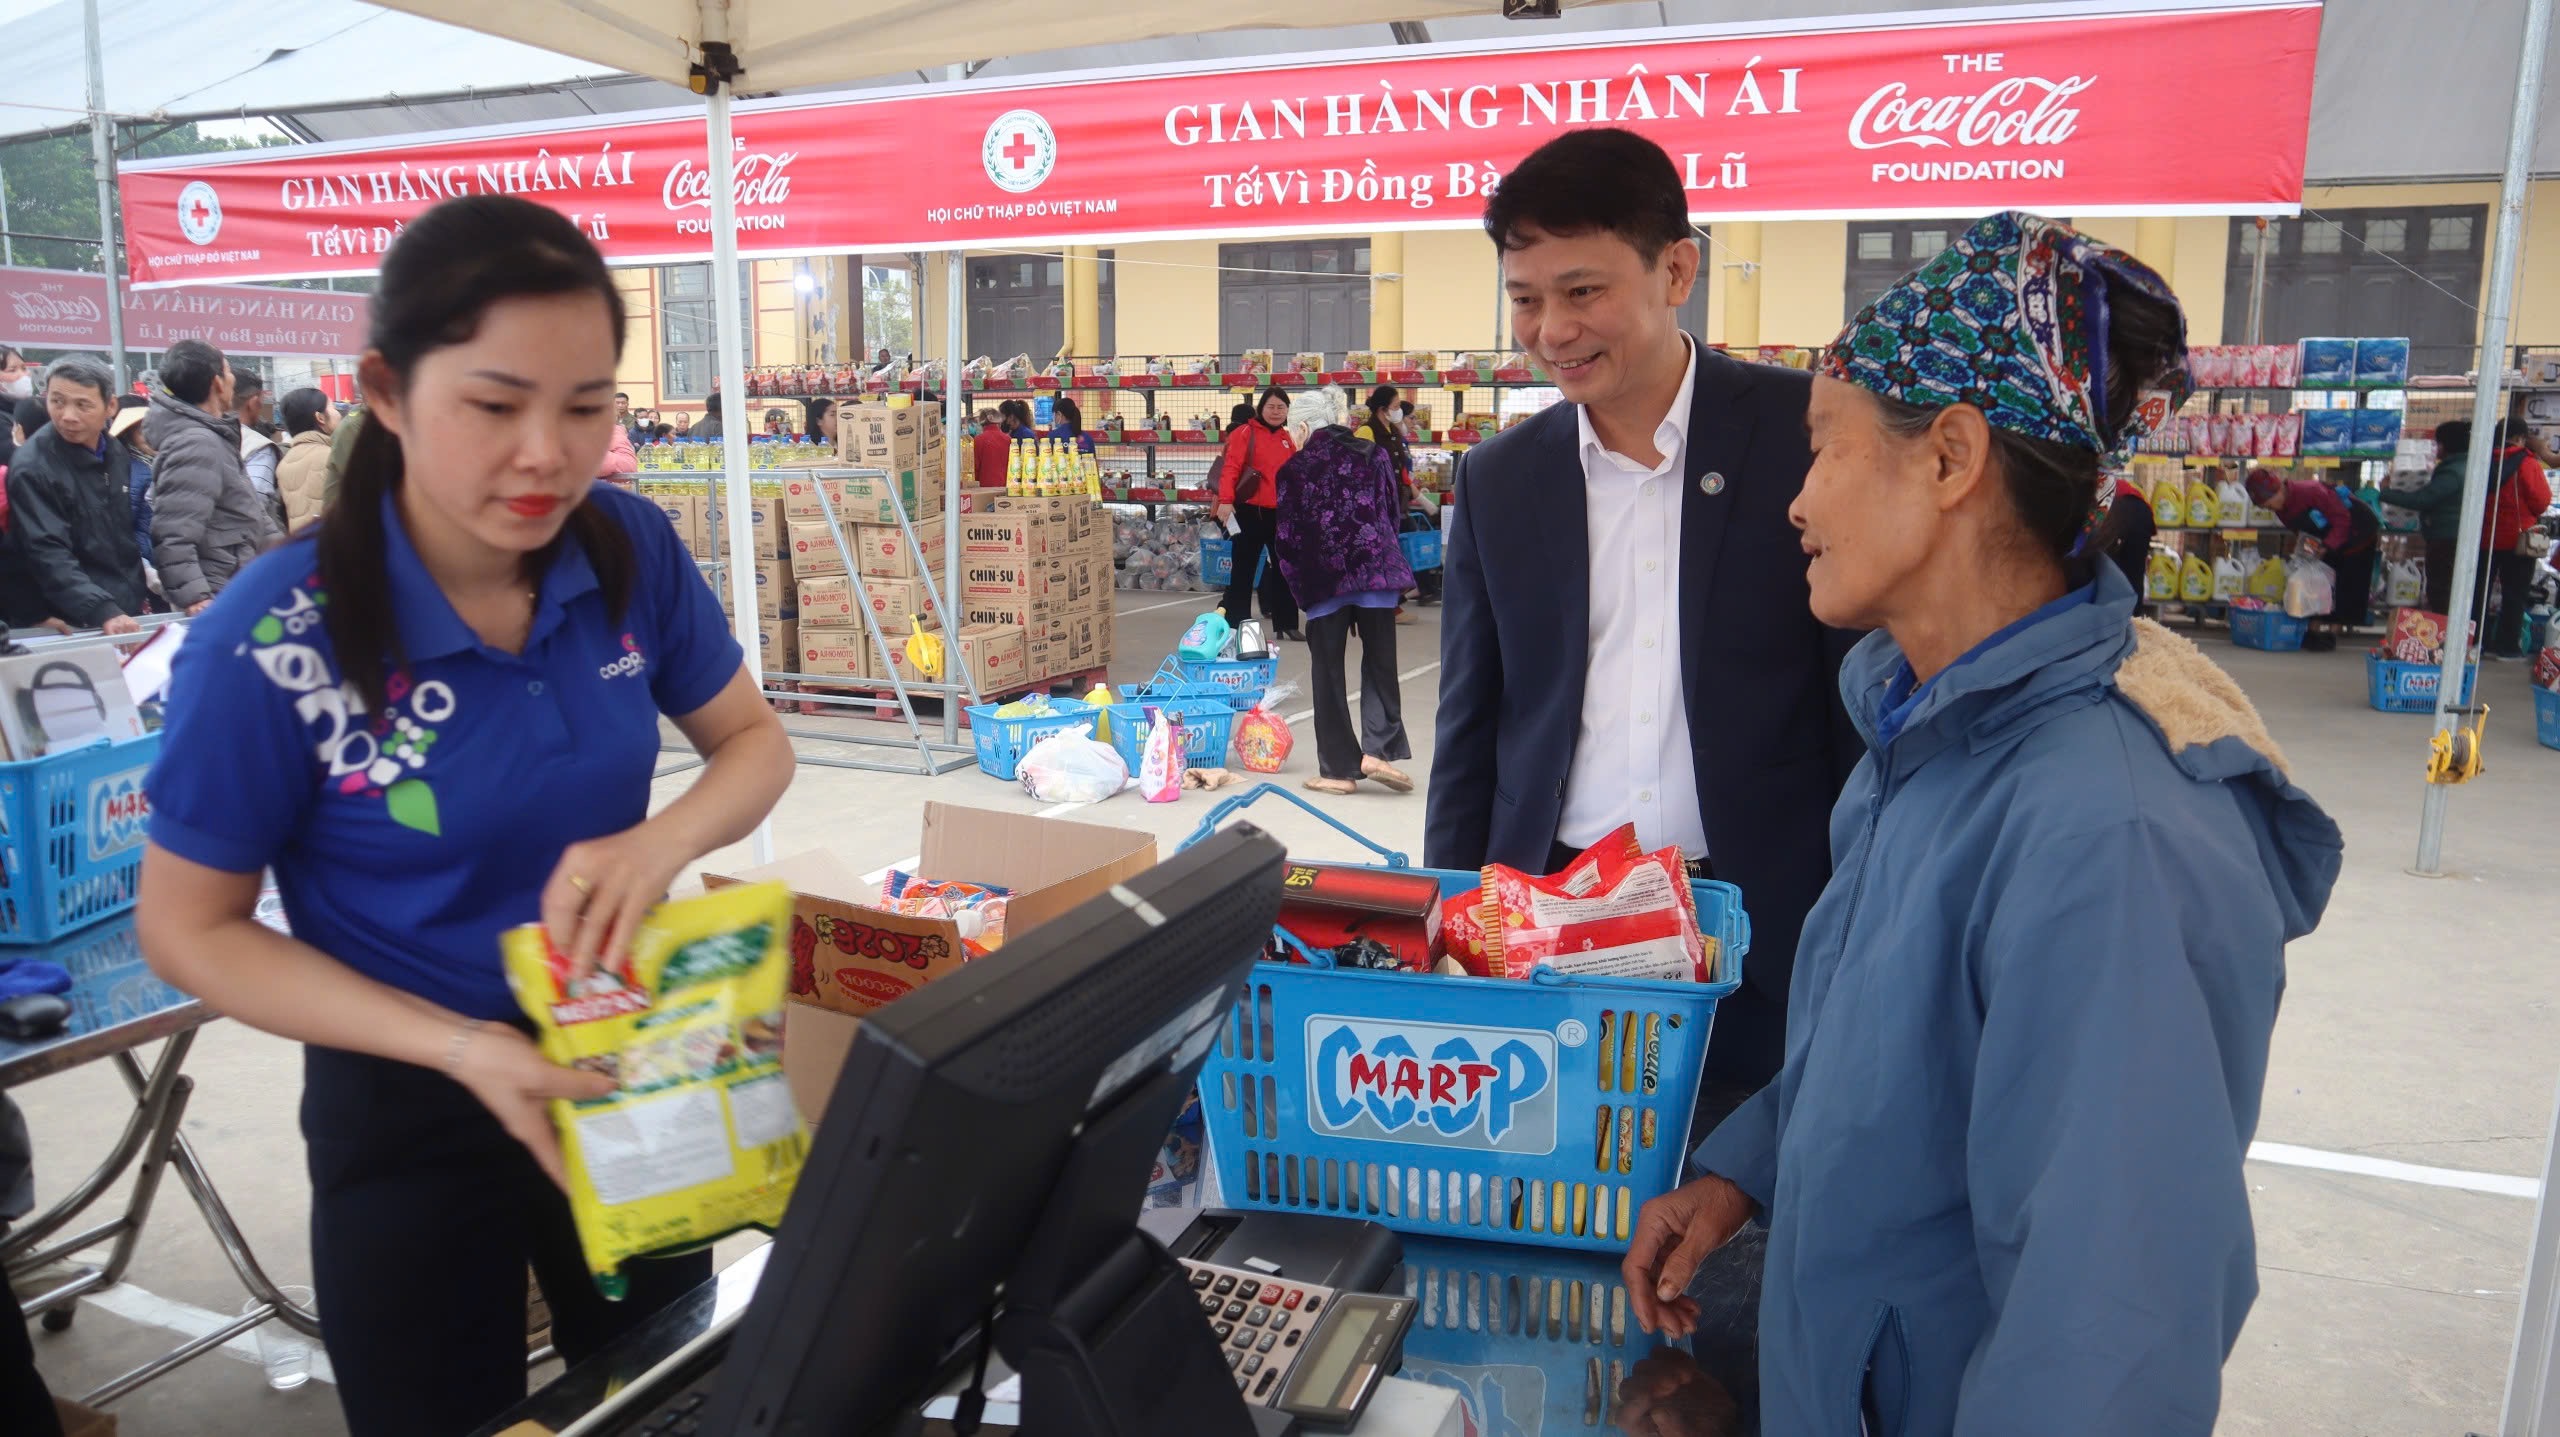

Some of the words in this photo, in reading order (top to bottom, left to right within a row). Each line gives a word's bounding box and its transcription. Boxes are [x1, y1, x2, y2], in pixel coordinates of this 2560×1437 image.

[1943, 53, 2004, 73] THE
[1163, 97, 1309, 147] GIAN
[1323, 79, 1503, 137] HÀNG
[1518, 63, 1711, 126] NHÂN
[1725, 55, 1804, 117] ÁI
[1848, 75, 2098, 150] Coca-Cola
[281, 174, 364, 211] GIAN
[370, 162, 469, 204] HÀNG
[476, 148, 585, 194] NHÂN
[592, 142, 637, 187] ÁI
[1321, 158, 1434, 209] Đồng
[1446, 160, 1503, 198] Bà
[1682, 152, 1748, 190] Lũ
[1871, 159, 2065, 183] FOUNDATION
[927, 208, 951, 225] HỘI
[953, 204, 985, 221] CHỮ
[986, 204, 1024, 221] THẬP
[1026, 201, 1047, 216] ĐỎ
[1050, 201, 1082, 218] VIỆT
[1085, 199, 1118, 213] NAM
[148, 256, 166, 269] HỘI
[166, 254, 182, 267] CHỮ
[183, 252, 206, 266] THẬP
[206, 250, 220, 263] ĐỎ
[219, 249, 241, 263] VIỆT
[241, 249, 260, 261] NAM
[967, 528, 1012, 541] CHIN-SU
[969, 569, 1014, 582] CHIN-SU
[970, 610, 1014, 624] CHIN-SU
[1349, 1053, 1498, 1106] MART
